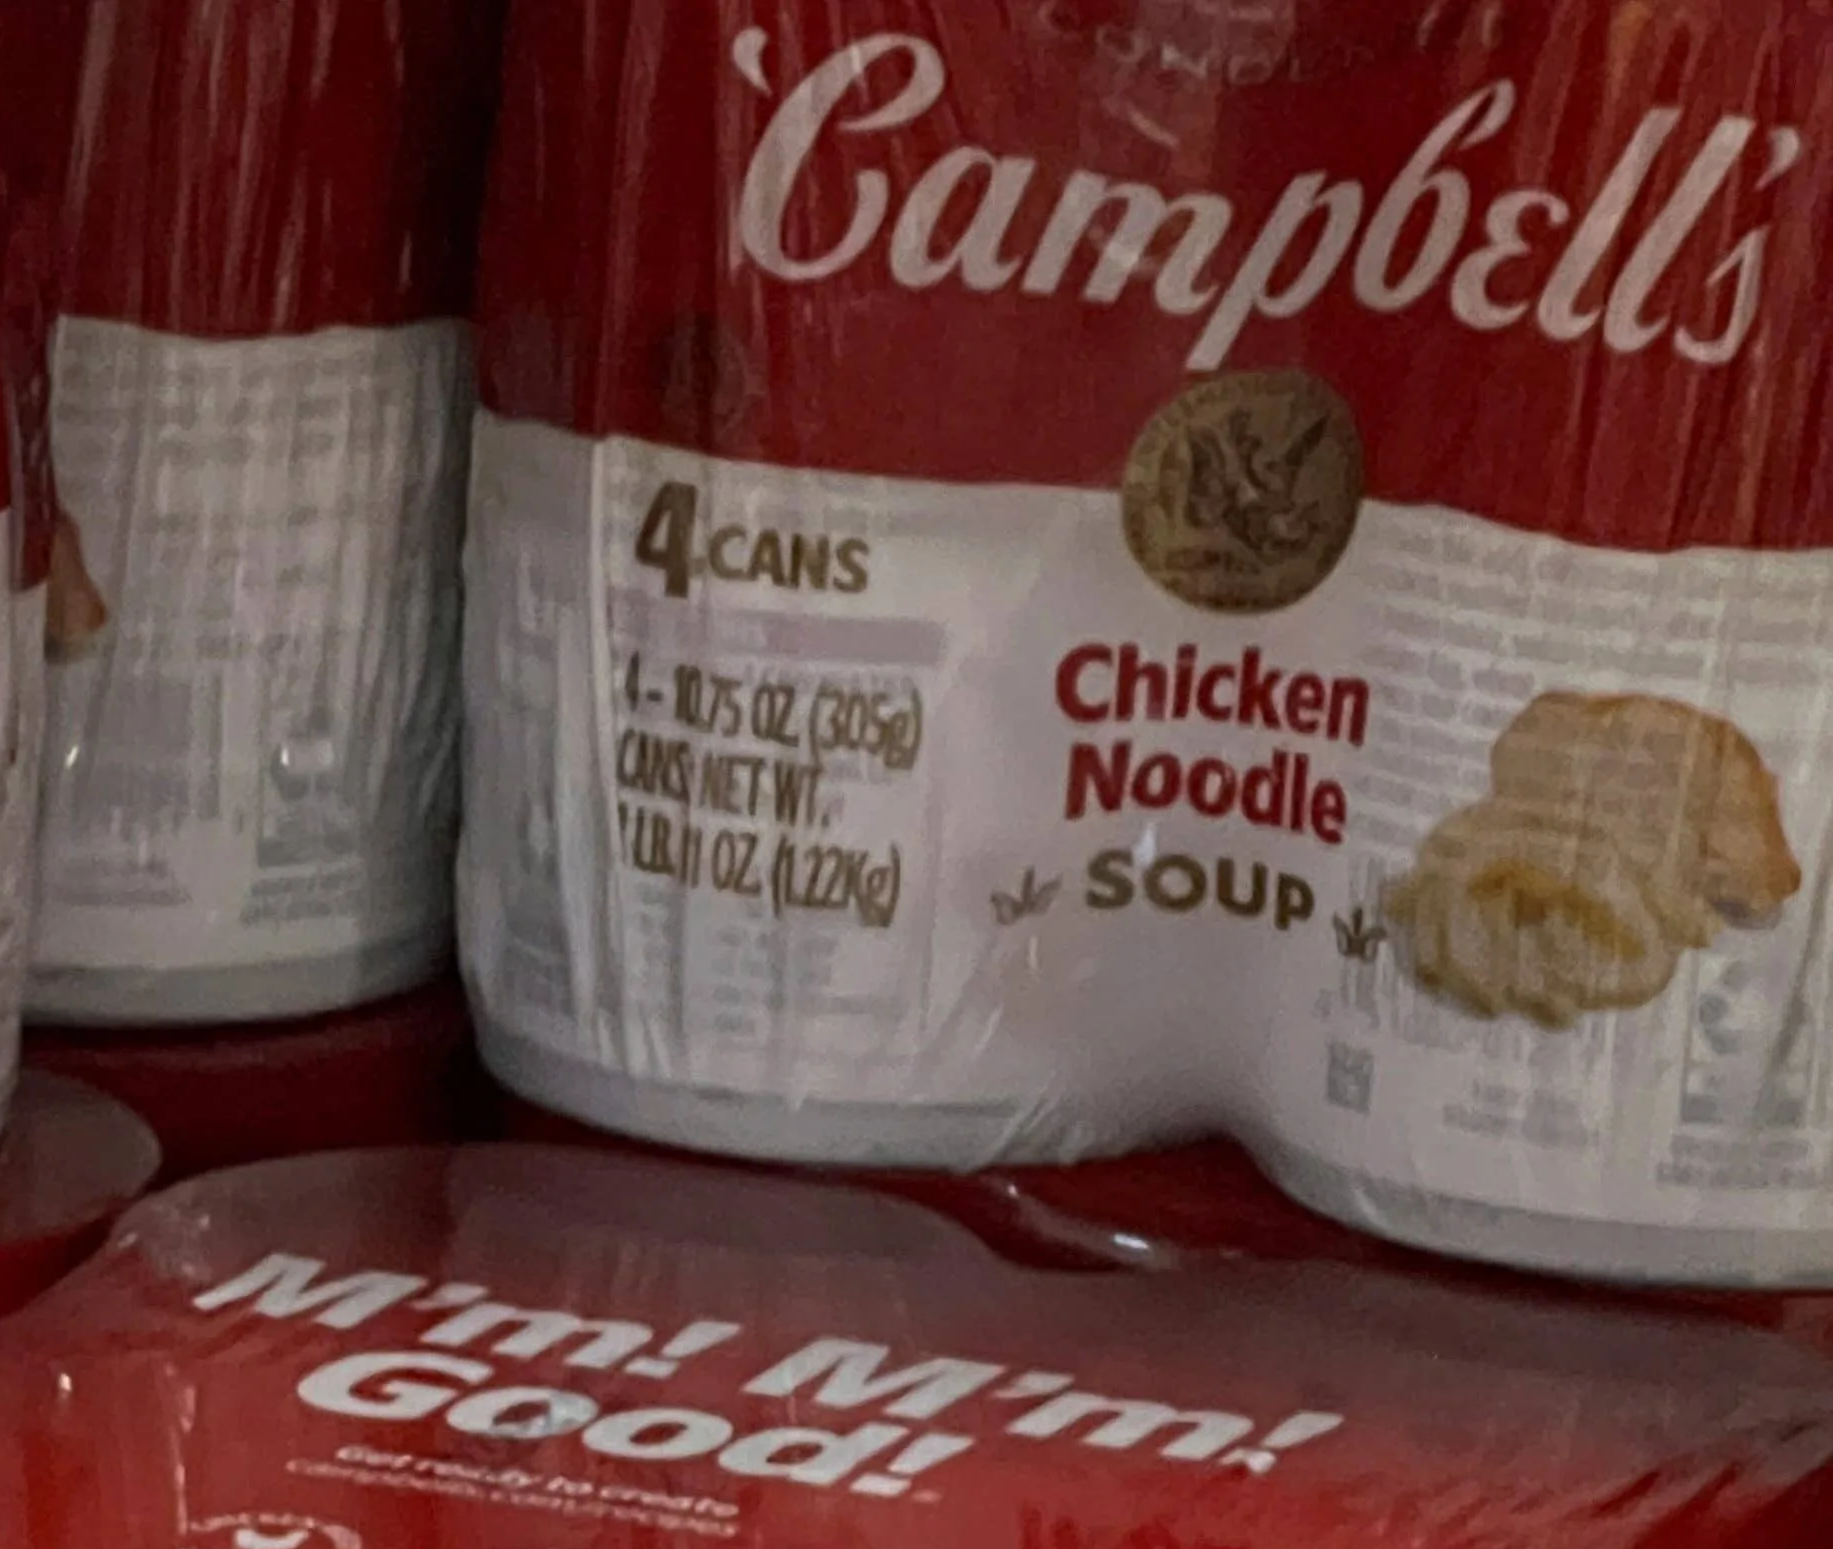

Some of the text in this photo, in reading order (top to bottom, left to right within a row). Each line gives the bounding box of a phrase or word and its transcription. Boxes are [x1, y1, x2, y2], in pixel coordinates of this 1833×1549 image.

[733, 26, 1801, 369] Campbell's
[636, 482, 871, 597] 4 CANS
[1055, 643, 1371, 746] Chicken
[1065, 739, 1348, 845] Noodle
[1085, 848, 1316, 931] SOUP
[192, 1252, 1345, 1475] M'm! M'm!
[296, 1349, 977, 1498] Good!
